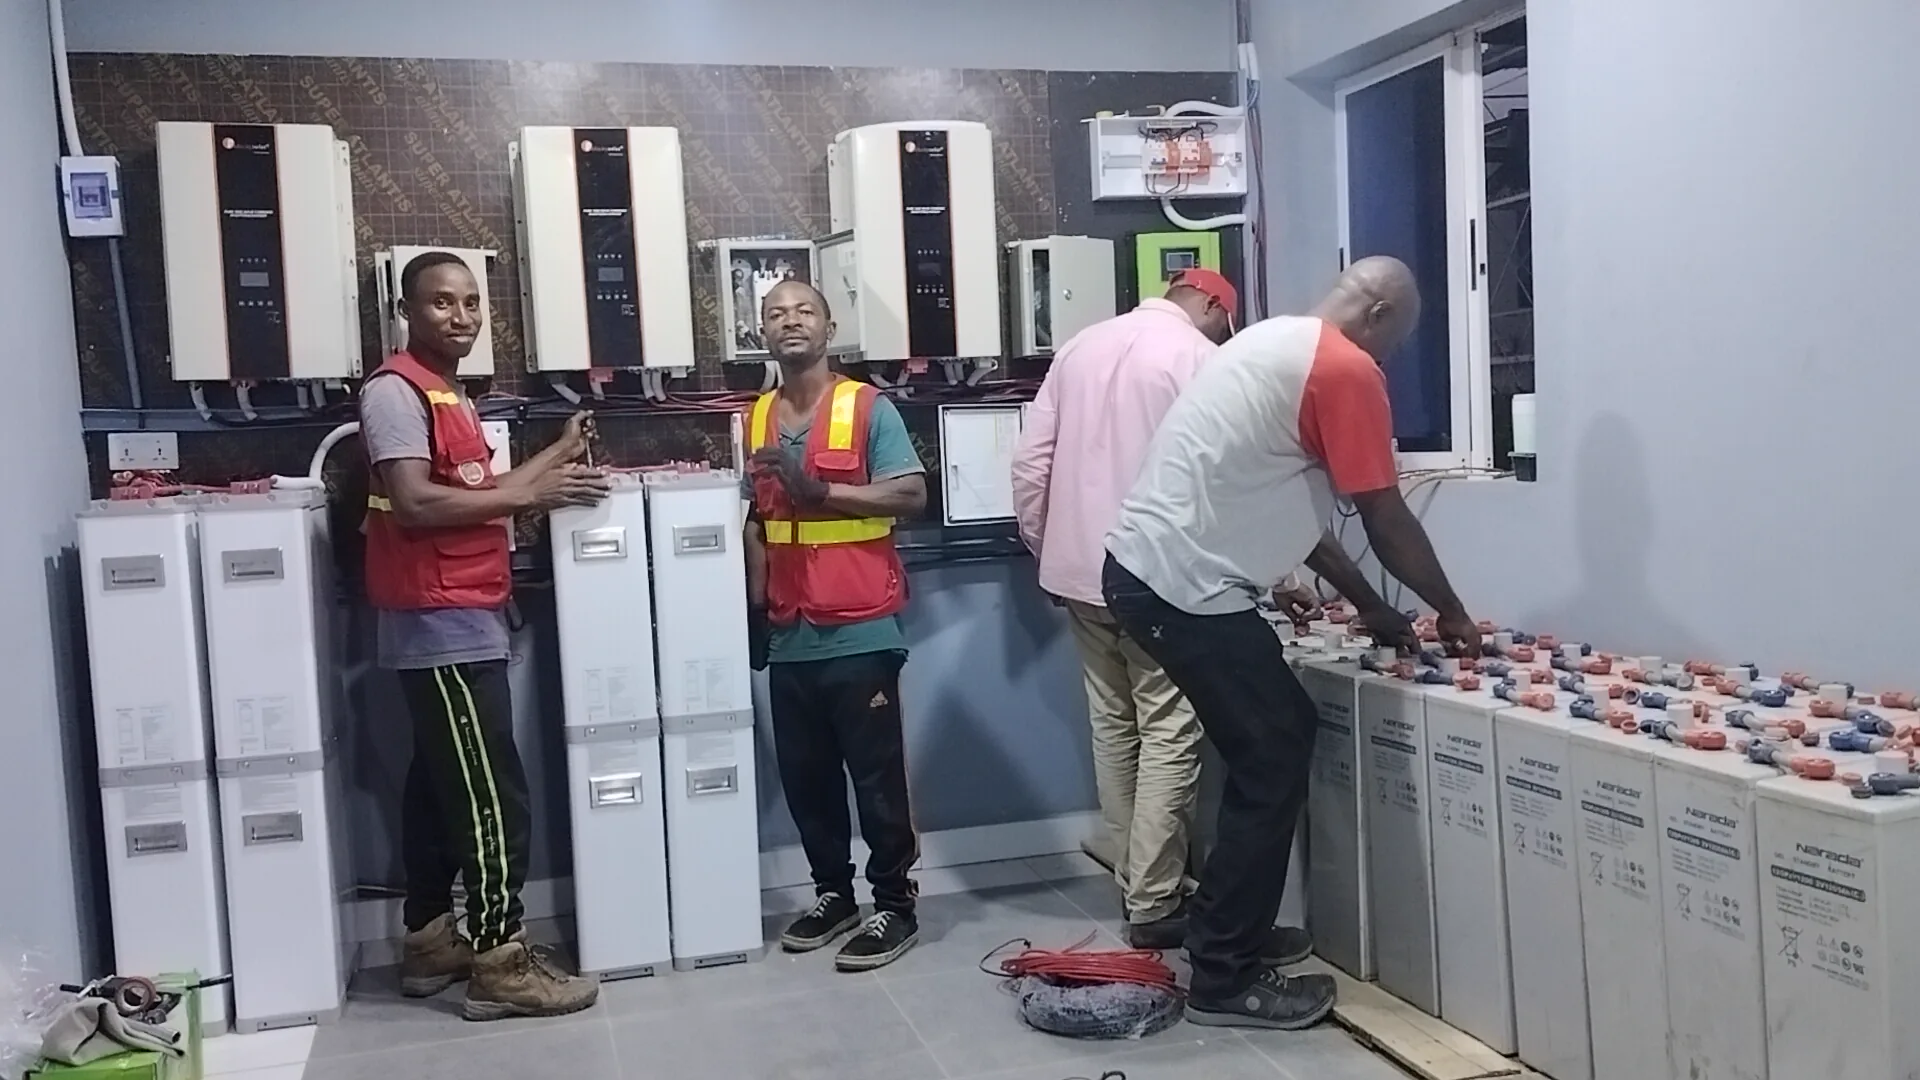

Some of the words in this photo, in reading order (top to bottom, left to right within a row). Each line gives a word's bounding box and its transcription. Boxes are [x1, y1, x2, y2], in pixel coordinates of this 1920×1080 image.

[403, 132, 450, 185] SUPER
[739, 135, 785, 186] SUPER
[345, 133, 413, 211] ATLANTIS
[1446, 733, 1482, 749] Narada
[1519, 756, 1560, 774] Narada
[1596, 780, 1641, 799] Narada
[1685, 806, 1737, 829] Narada
[1796, 842, 1861, 869] Narada
